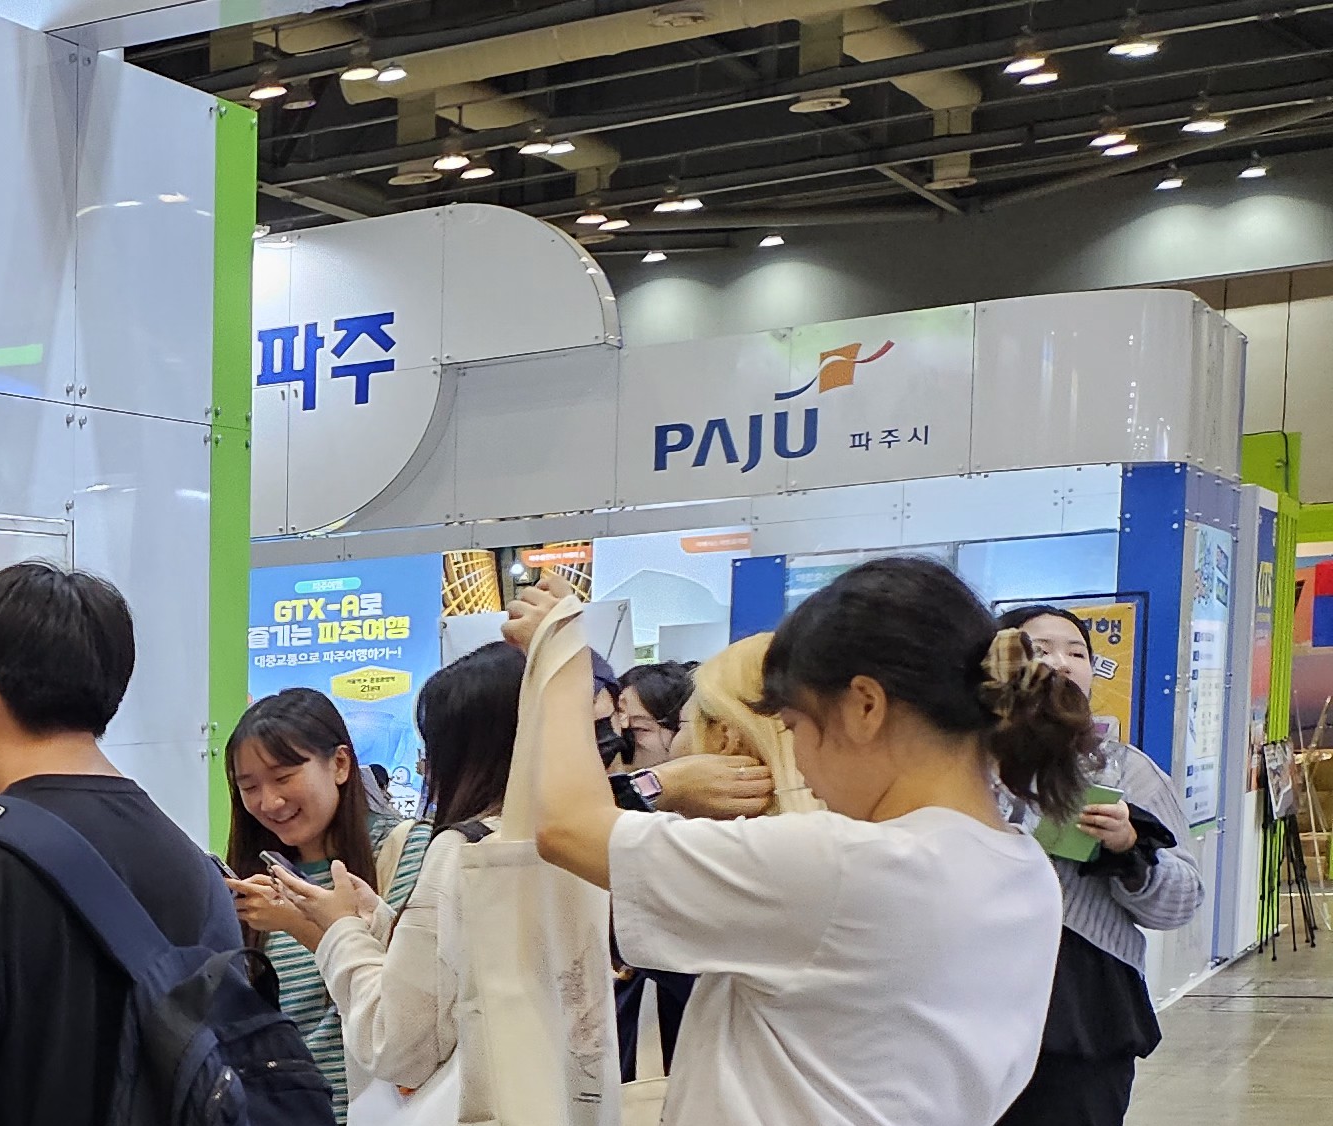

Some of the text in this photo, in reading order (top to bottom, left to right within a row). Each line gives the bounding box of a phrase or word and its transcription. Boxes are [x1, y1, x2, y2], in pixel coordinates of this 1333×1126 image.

[256, 311, 397, 412] 파주
[653, 407, 819, 473] PAJU
[849, 425, 930, 451] 파주시
[274, 592, 383, 623] GTX-A로
[247, 615, 411, 649] 즐기는 파주여행
[254, 652, 320, 669] 대중교통으로
